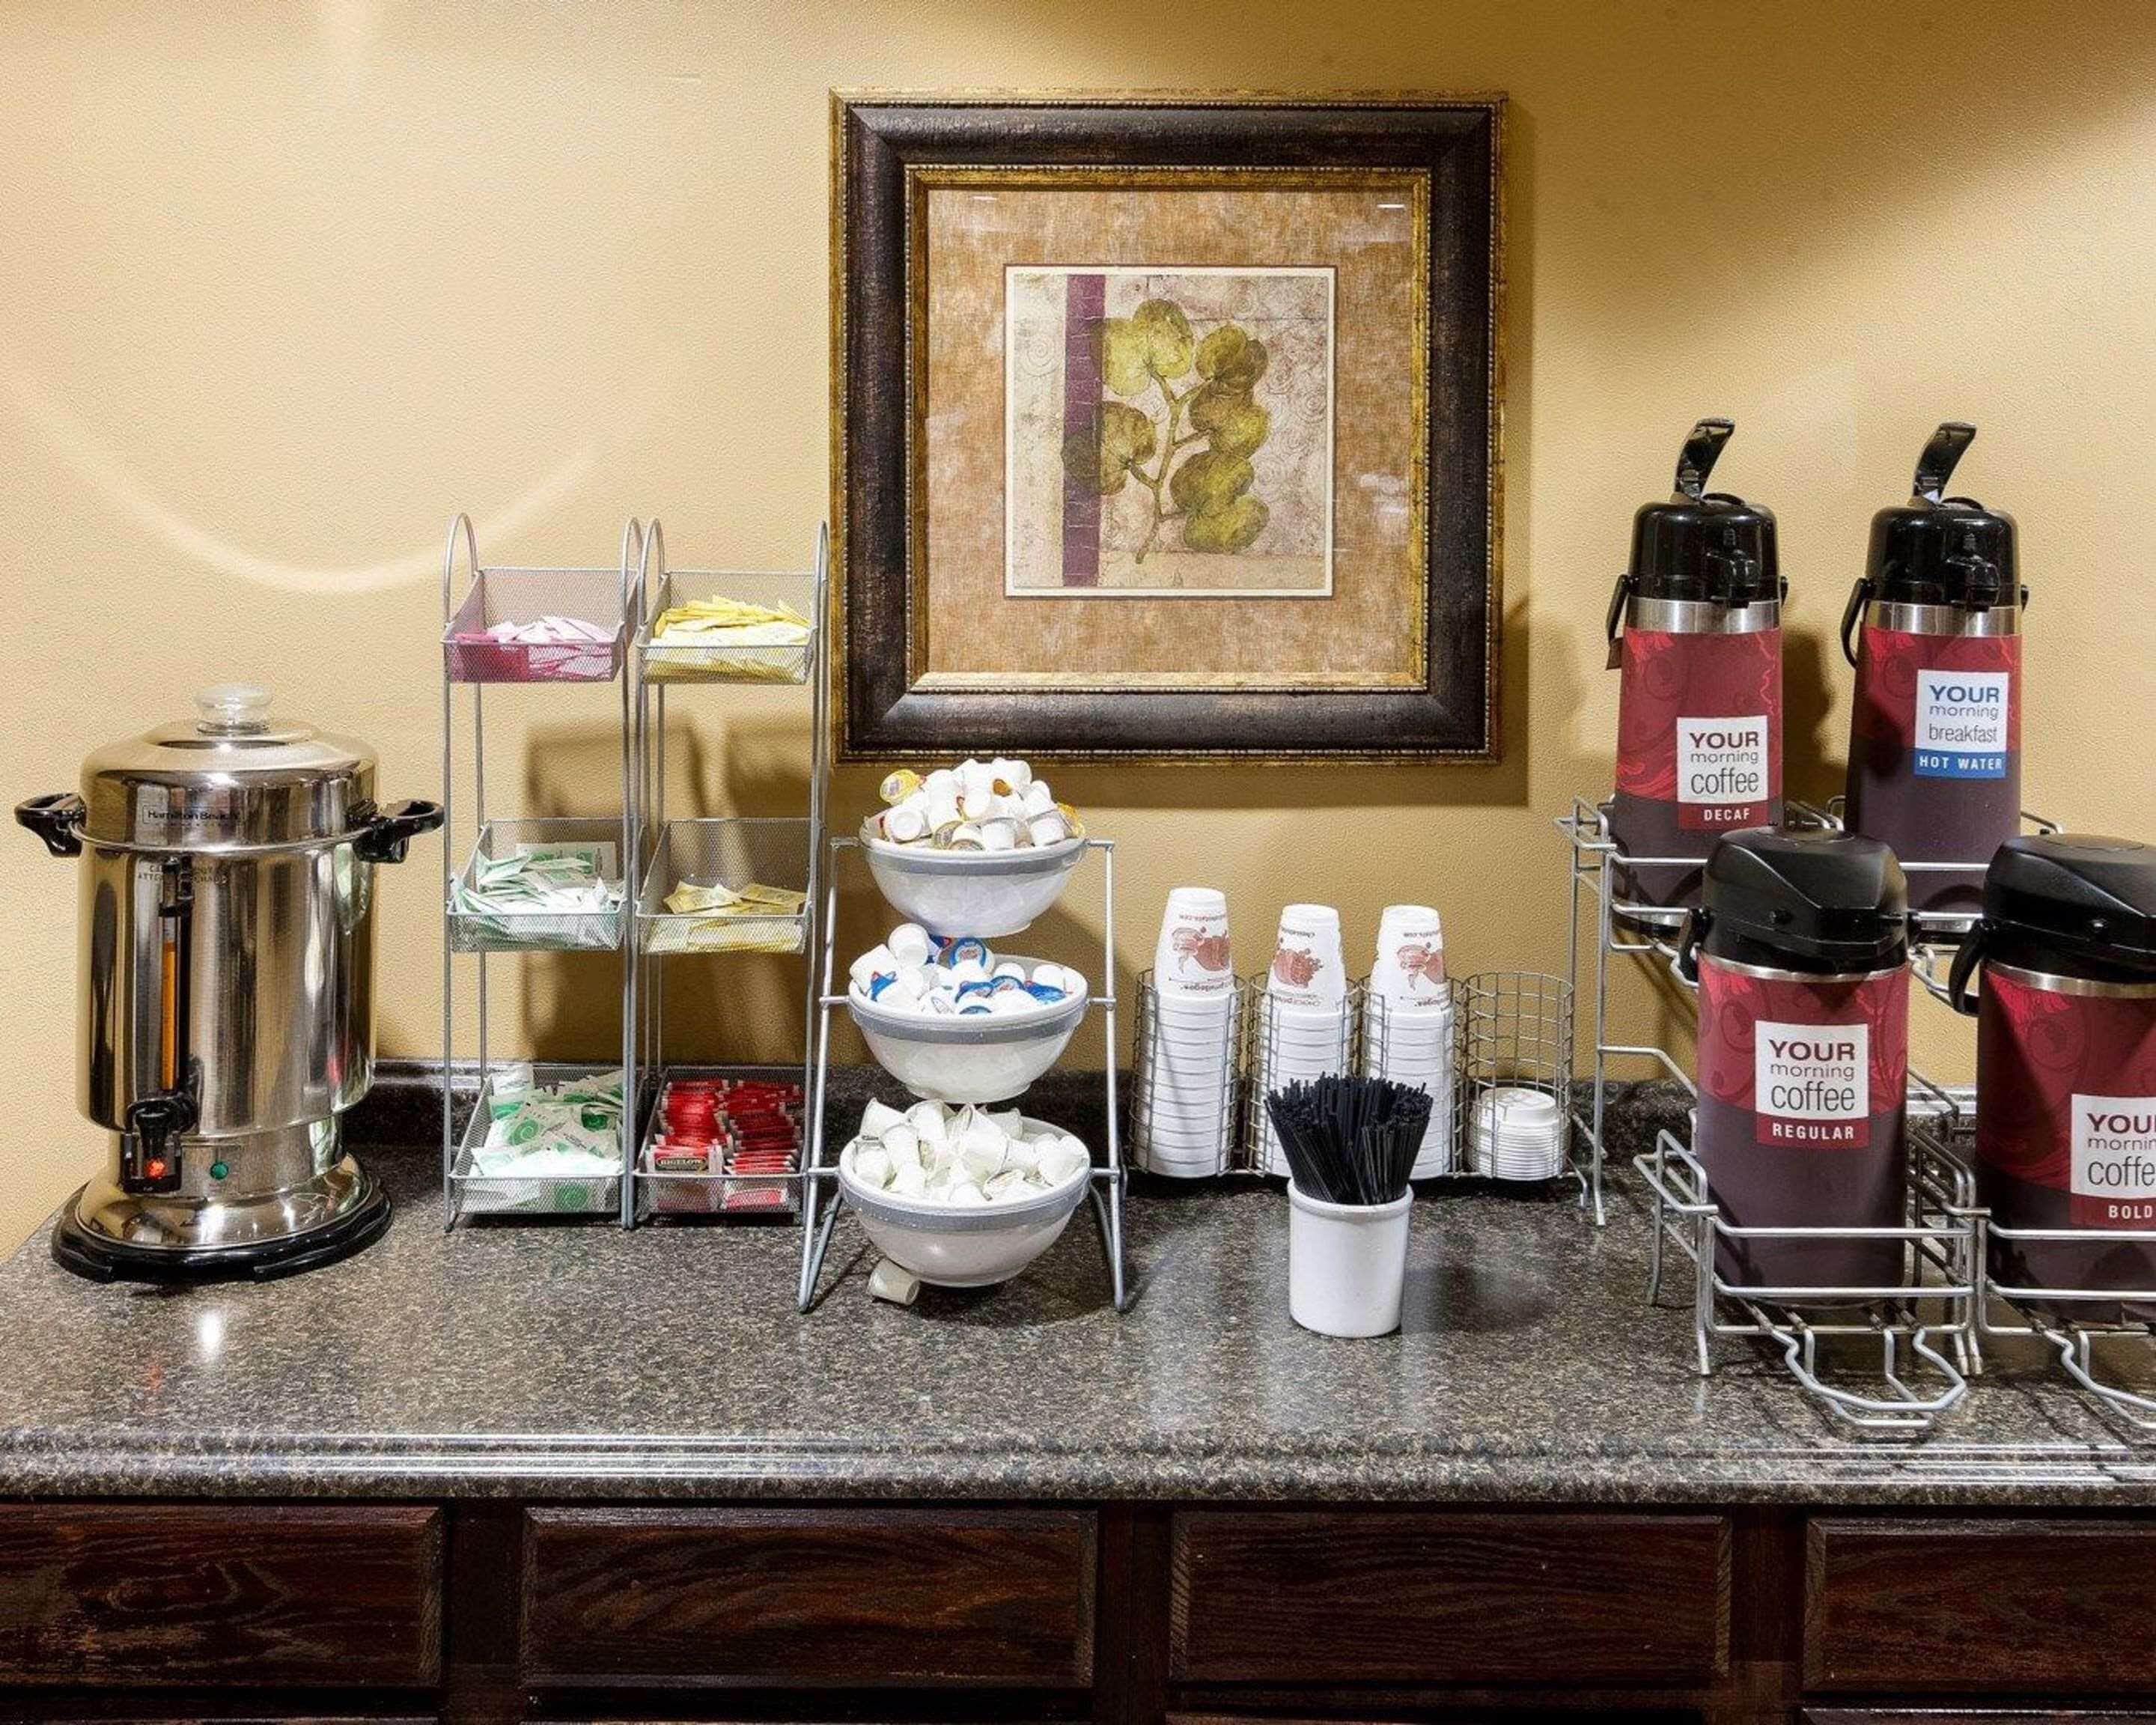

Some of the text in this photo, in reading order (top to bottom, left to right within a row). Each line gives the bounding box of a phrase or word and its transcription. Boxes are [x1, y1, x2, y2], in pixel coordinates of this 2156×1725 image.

[1929, 684, 2000, 703] YOUR
[1928, 705, 1999, 720] morning
[1689, 731, 1759, 749] YOUR
[1928, 723, 1998, 743] breakfast
[1690, 750, 1758, 764] morning
[1919, 755, 2003, 770] HOT WATER
[1690, 767, 1759, 794] coffee
[147, 810, 240, 821] Hamilton Beach
[1703, 808, 1750, 821] DECAF
[1768, 1039, 1856, 1062] YOUR
[1770, 1063, 1855, 1082] morning
[1771, 1081, 1856, 1112] coffee
[1772, 1122, 1854, 1140] REGULAR
[2086, 1113, 2156, 1134] YOU
[2107, 1205, 2153, 1220] BOLD
